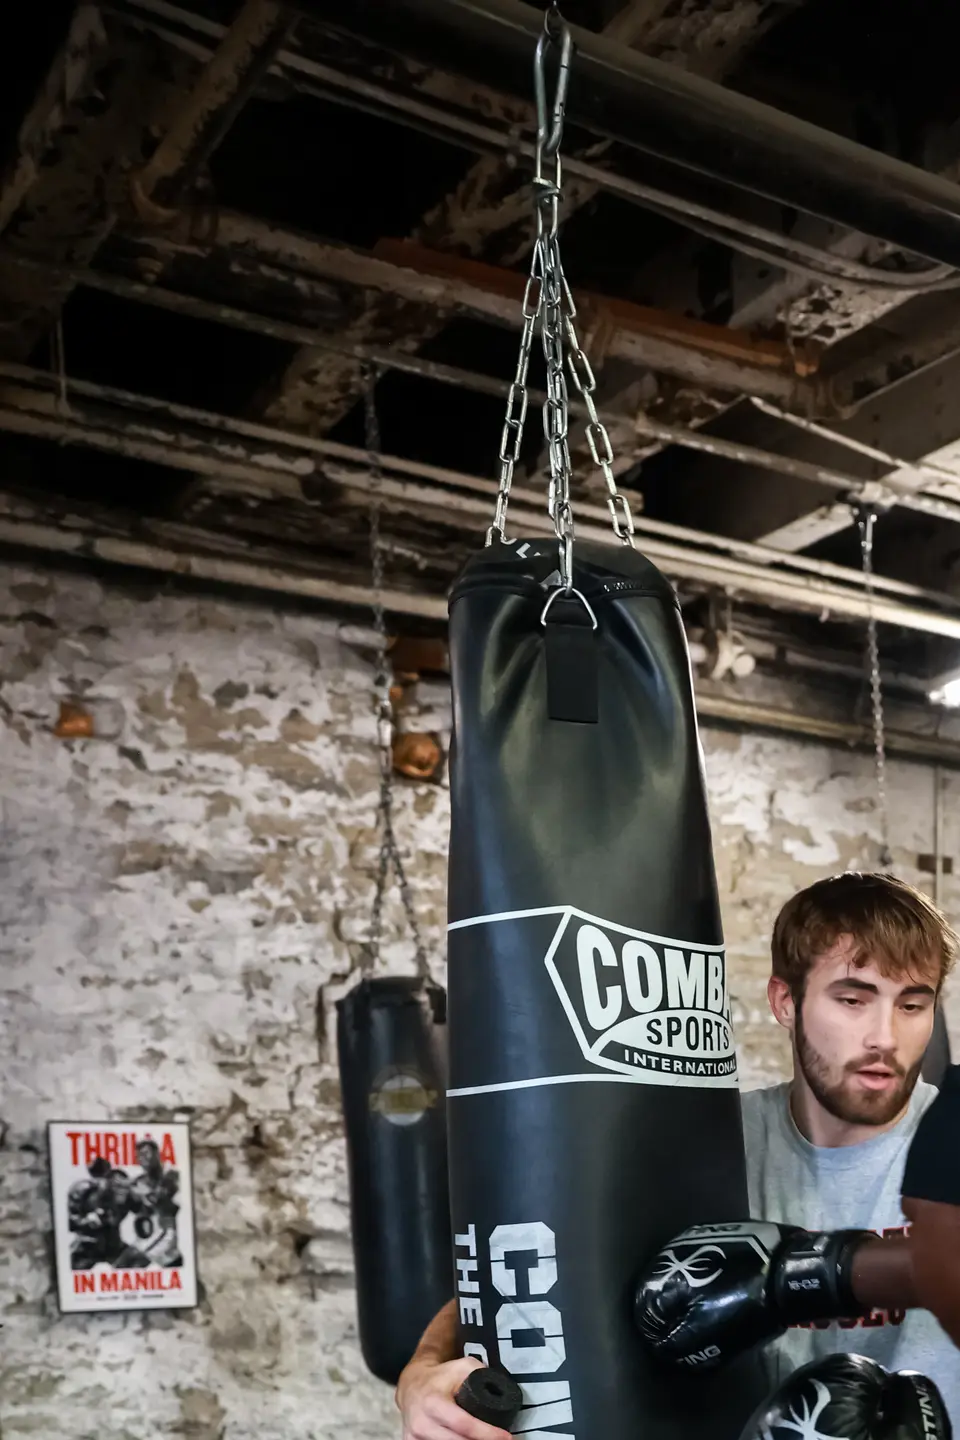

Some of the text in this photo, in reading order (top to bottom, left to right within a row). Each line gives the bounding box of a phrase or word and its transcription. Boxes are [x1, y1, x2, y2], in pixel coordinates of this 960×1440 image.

[576, 924, 733, 1032] COMB
[646, 1016, 729, 1051] SPORTS
[624, 1049, 736, 1075] INTERNATIONAL
[66, 1132, 176, 1166] THRILA
[73, 1270, 182, 1294] IN MANILA
[455, 1224, 483, 1326] THE
